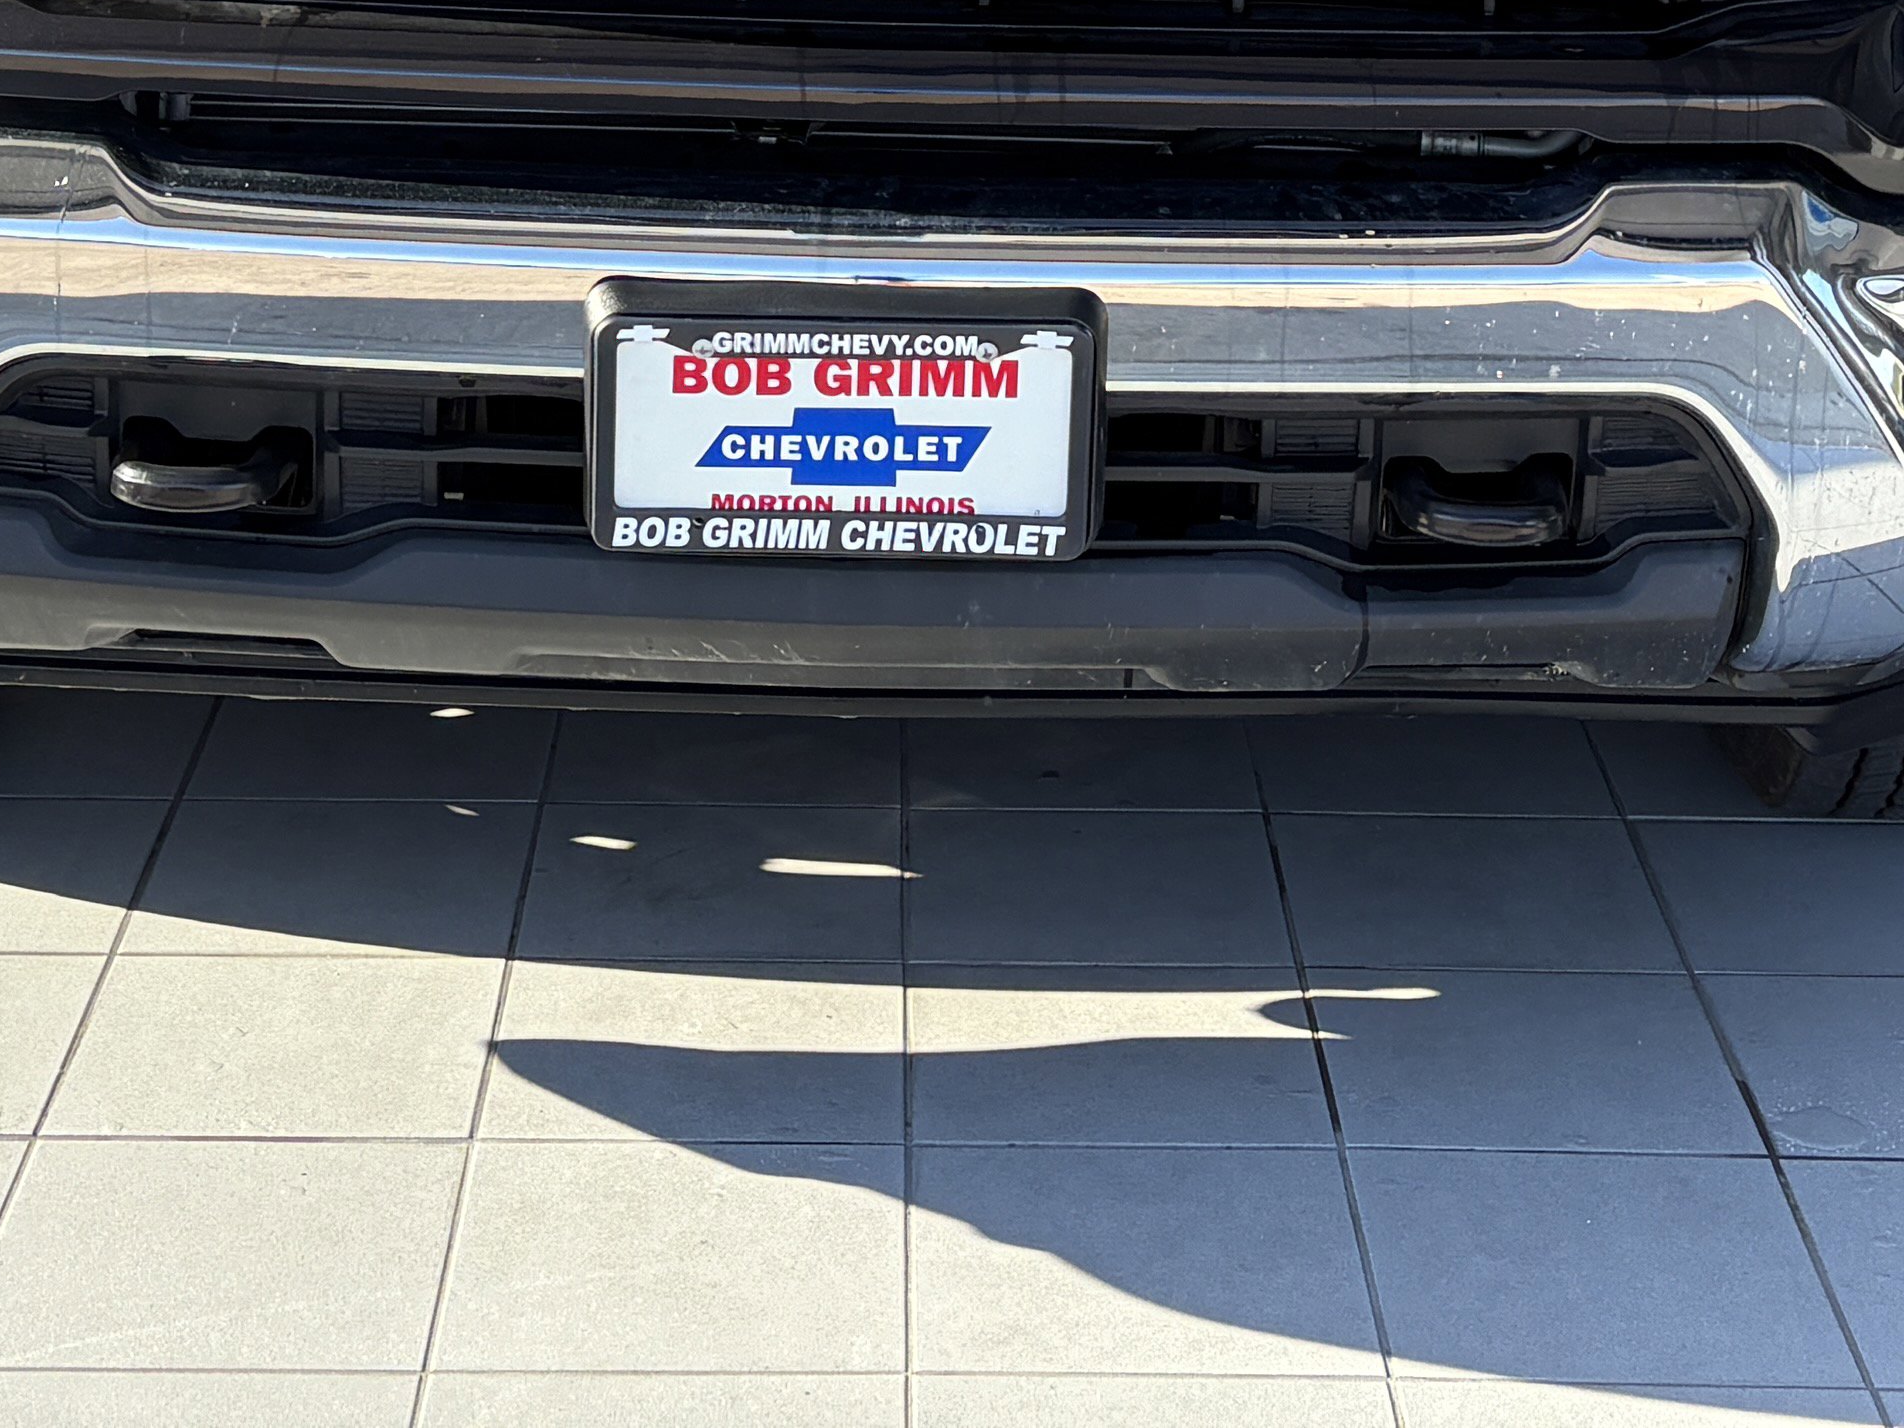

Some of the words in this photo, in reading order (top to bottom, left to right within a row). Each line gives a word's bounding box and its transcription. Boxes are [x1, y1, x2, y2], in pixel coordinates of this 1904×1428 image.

[712, 332, 979, 356] GRIMMCHEVY.COM
[672, 356, 792, 396] BOB
[814, 358, 1018, 399] GRIMM
[721, 433, 963, 463] CHEVROLET
[711, 493, 833, 512] MORTON
[611, 516, 692, 548] BOB
[702, 518, 829, 550] GRIMM
[840, 520, 1066, 556] CHEVROLET
